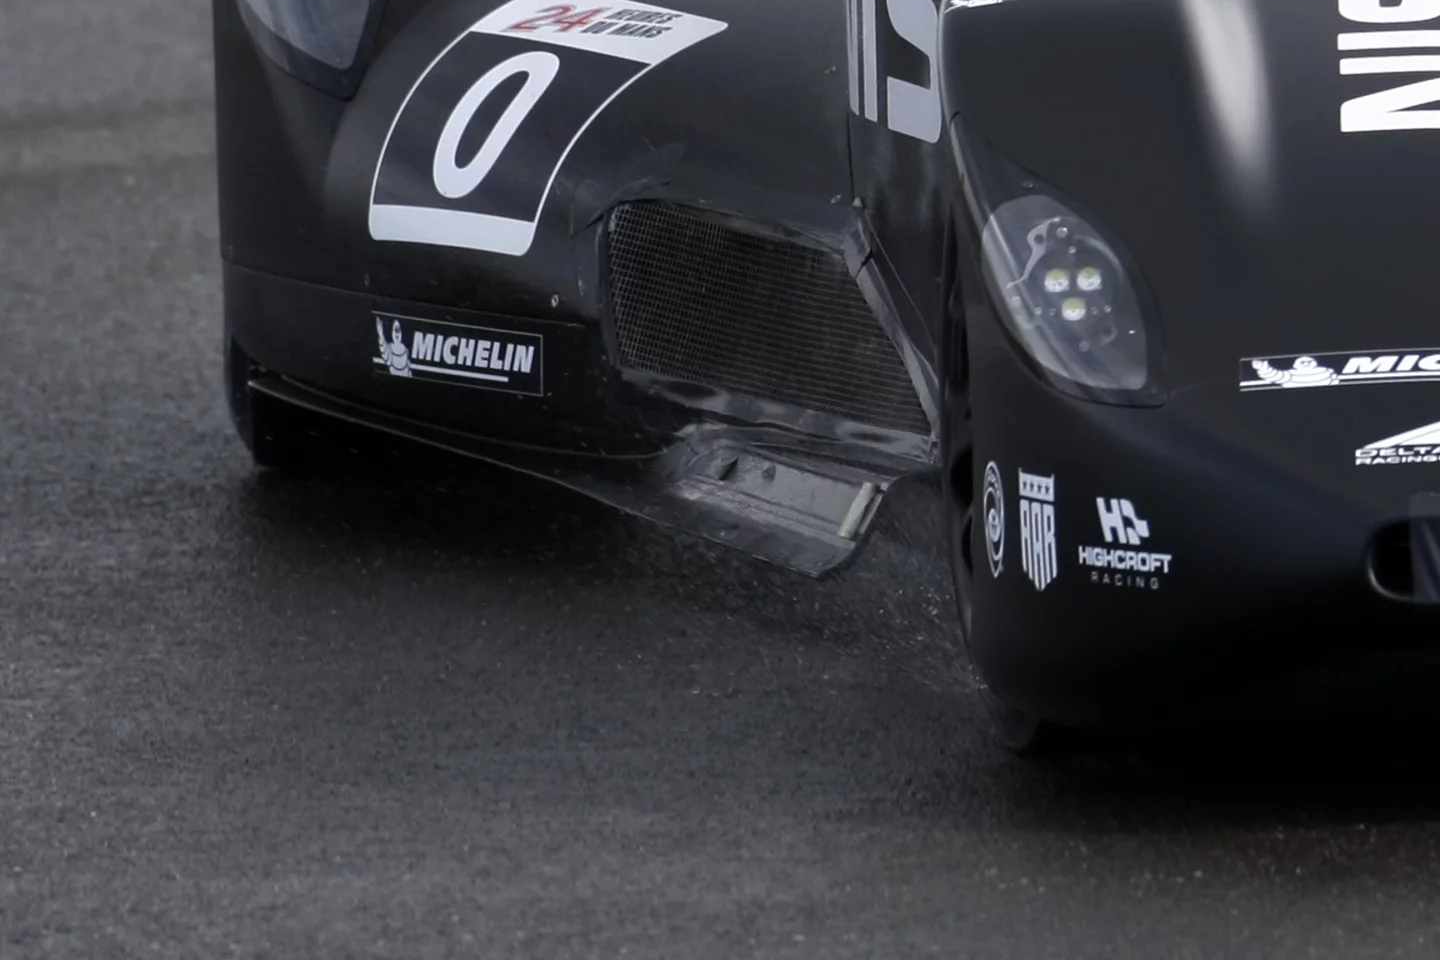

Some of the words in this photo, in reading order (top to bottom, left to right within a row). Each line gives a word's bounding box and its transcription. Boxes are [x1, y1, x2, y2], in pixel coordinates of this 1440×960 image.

[501, 3, 613, 33] 24
[433, 51, 560, 198] 0
[411, 331, 535, 373] MICHELIN
[1078, 545, 1172, 573] HIGHCROFT
[1091, 571, 1160, 589] RACING
